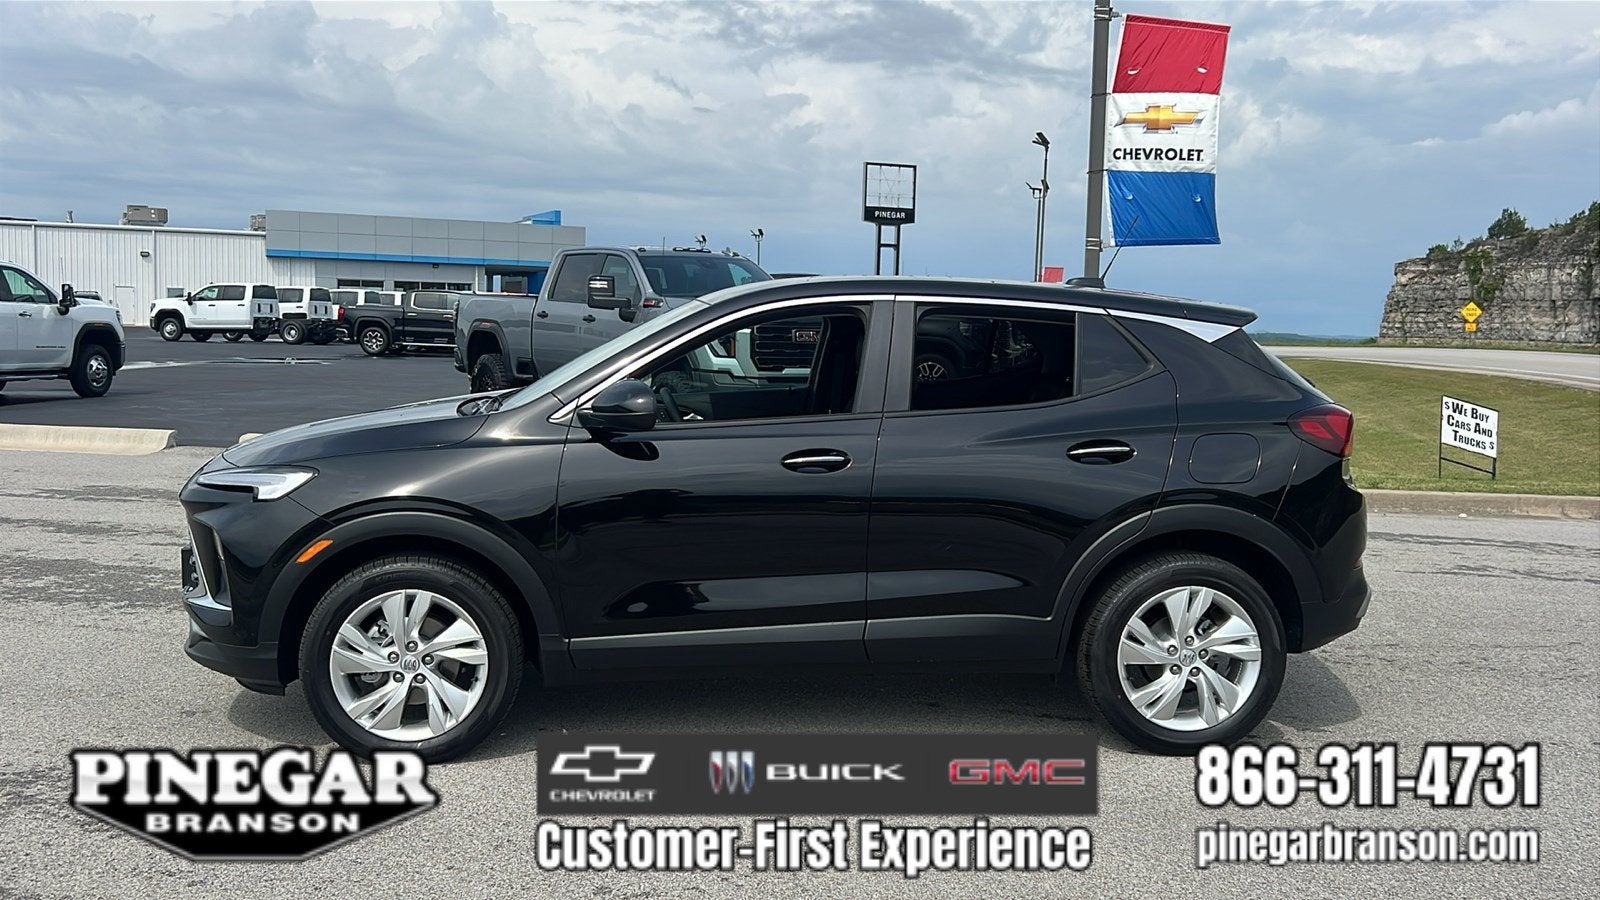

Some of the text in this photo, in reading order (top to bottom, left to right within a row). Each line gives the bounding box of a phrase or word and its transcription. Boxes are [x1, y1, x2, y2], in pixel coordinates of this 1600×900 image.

[1112, 147, 1204, 162] CHEVROLET
[874, 210, 906, 219] PINEGAR
[1471, 407, 1490, 423] BUY
[1447, 414, 1493, 438] CARS AND
[1452, 429, 1487, 450] TRUCKS
